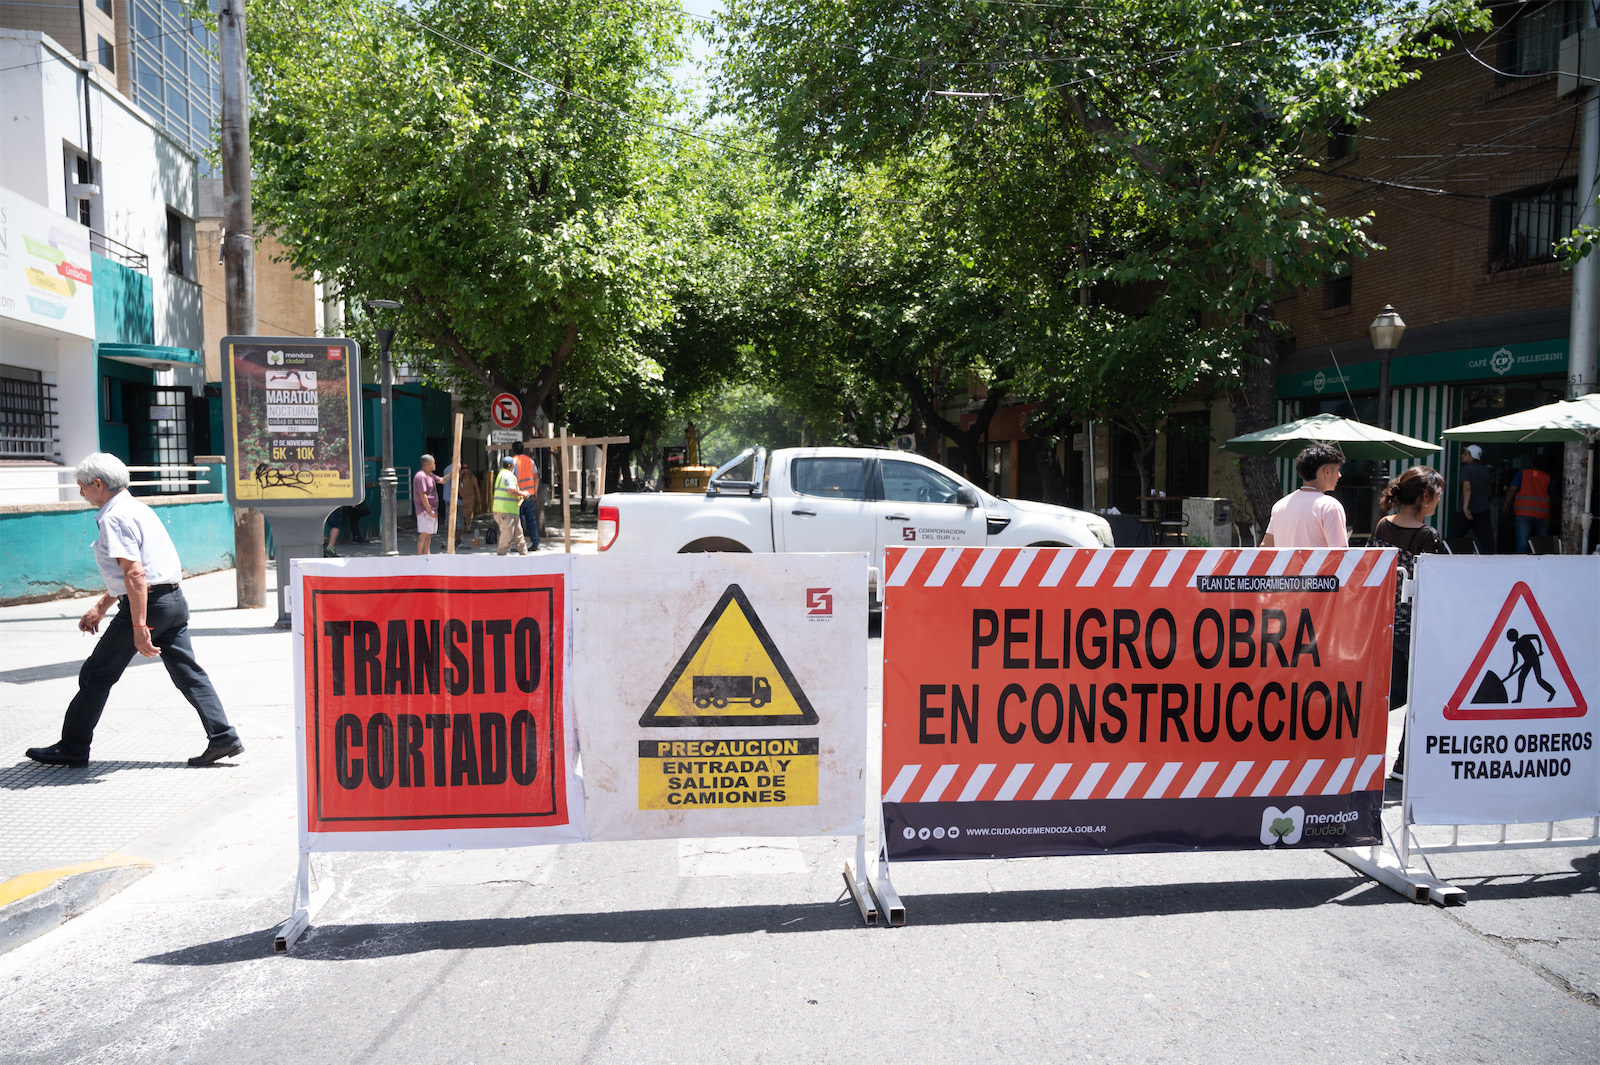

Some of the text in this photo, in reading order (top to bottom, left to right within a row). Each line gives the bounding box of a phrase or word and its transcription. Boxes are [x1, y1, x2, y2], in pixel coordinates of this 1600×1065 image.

[35, 274, 57, 290] Flexibles
[1468, 352, 1563, 368] CAFÉ CP PELLEGRINI
[269, 406, 316, 417] NOCTURNA
[272, 447, 315, 460] 5K 10K
[684, 478, 699, 487] CAT
[1201, 578, 1336, 590] PLAN DE MEJORAMIENTO URBANO
[971, 607, 1321, 670] PELIGRO OBRA
[324, 617, 541, 696] TRANSITO
[918, 680, 1363, 744] EN CONSTRUCCION
[334, 709, 538, 790] CORTADO
[657, 739, 799, 757] PRECAUCION
[1426, 732, 1592, 754] PELIGRO OBREROS
[663, 760, 791, 774] ENTRADA Y
[1451, 757, 1571, 779] TRABAJANDO
[668, 775, 786, 790] SALIDA DE
[667, 790, 787, 805] CAMIONES
[1305, 808, 1359, 824] mendoza
[966, 825, 1106, 837] WWW.CIUDADDEMENDOZA.GOB.AR
[1304, 823, 1347, 836] ciudad
